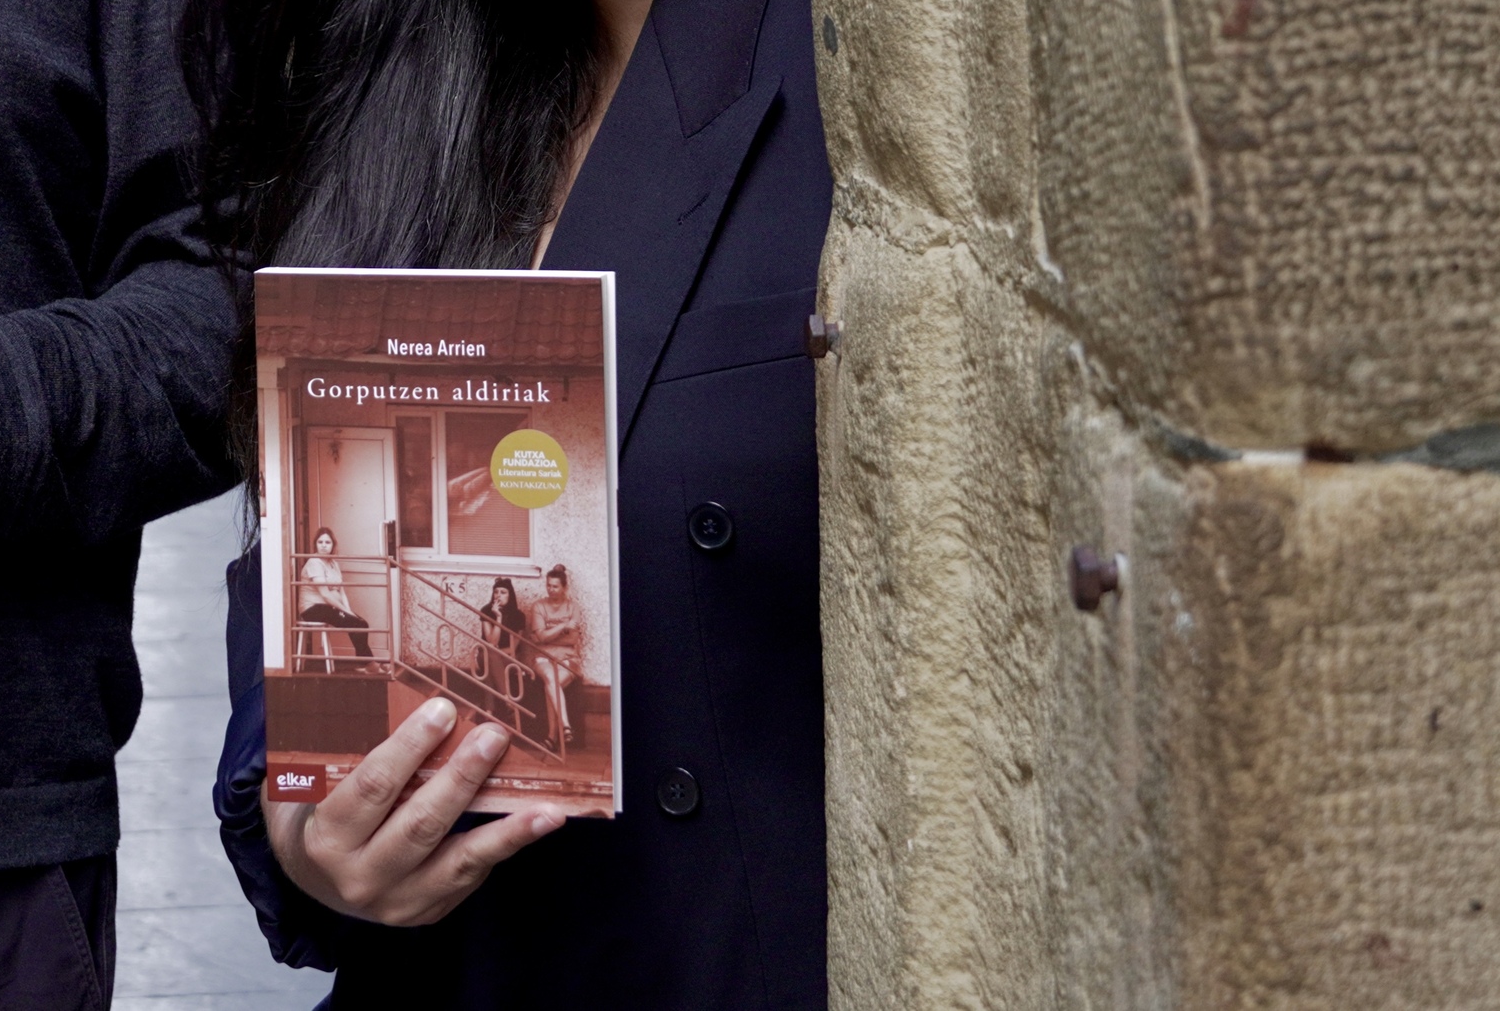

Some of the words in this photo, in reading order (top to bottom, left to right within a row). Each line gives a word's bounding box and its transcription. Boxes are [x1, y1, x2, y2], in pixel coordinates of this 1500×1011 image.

[387, 338, 433, 356] Nerea
[437, 339, 486, 357] Arrien
[307, 377, 440, 405] Gorputzen
[452, 380, 551, 403] aldiriak
[514, 450, 545, 459] KUTXA
[502, 458, 557, 468] FUNDAZIOA
[498, 468, 537, 477] Literatura
[538, 469, 562, 478] Sariak
[500, 481, 561, 490] KONTAKIZUNA
[276, 772, 315, 787] elkar
